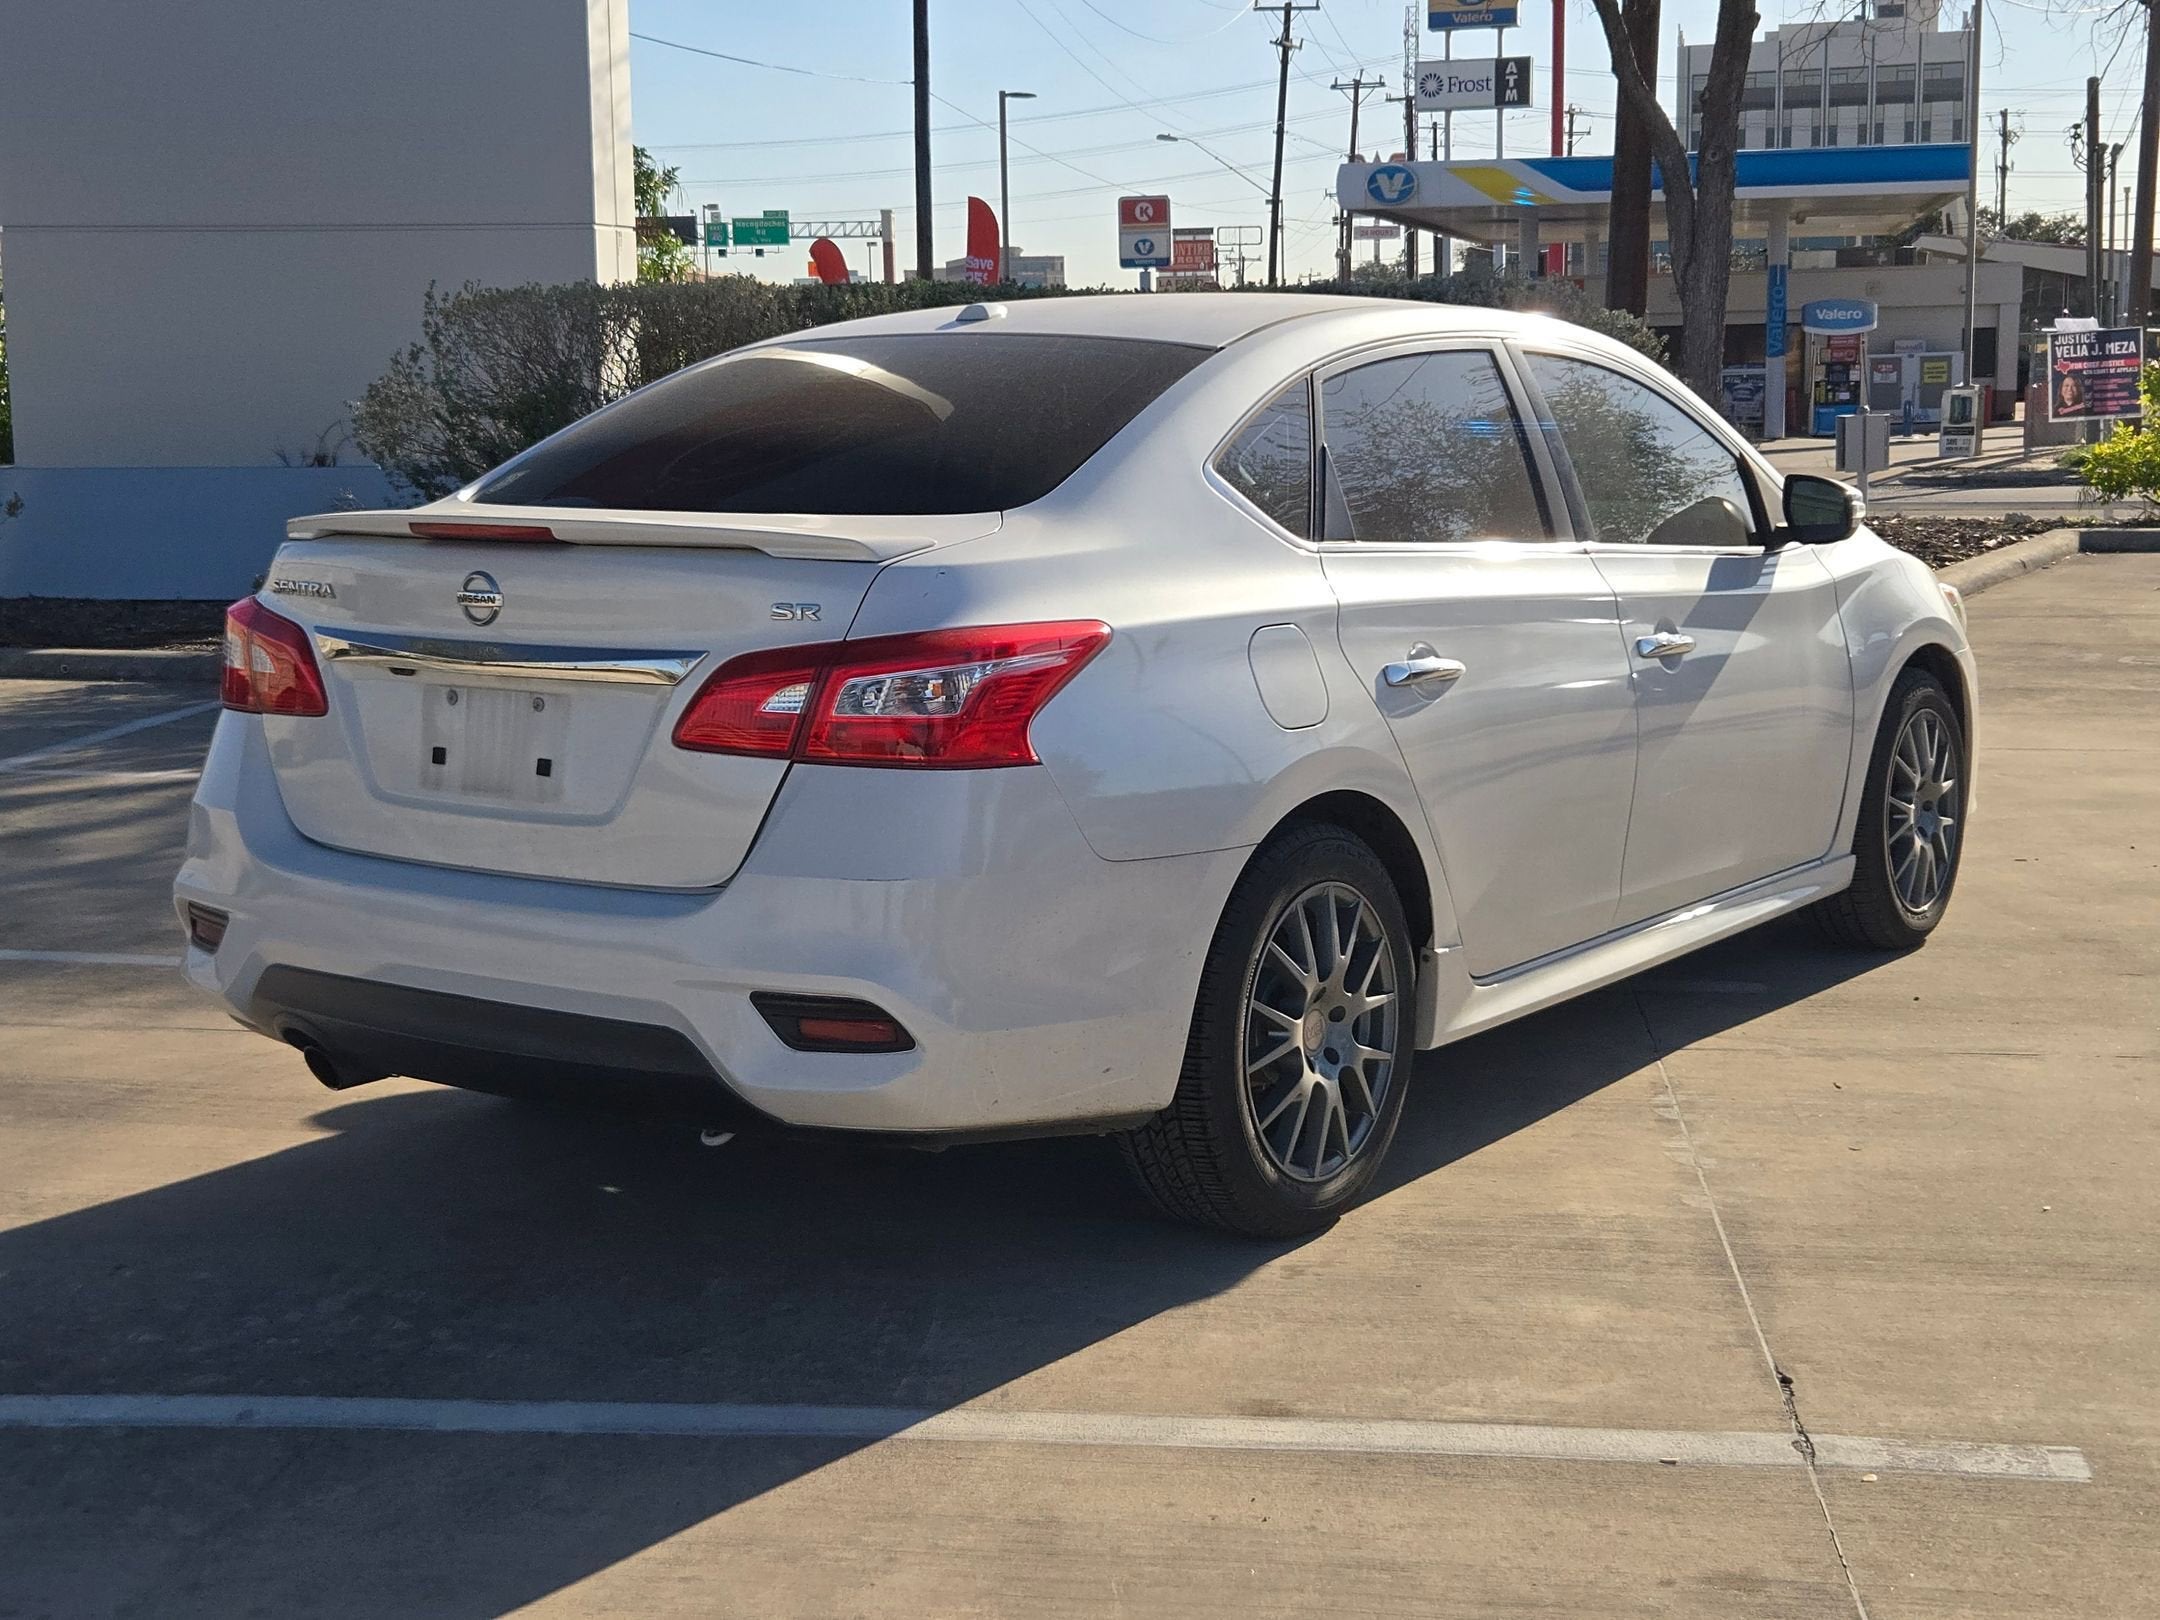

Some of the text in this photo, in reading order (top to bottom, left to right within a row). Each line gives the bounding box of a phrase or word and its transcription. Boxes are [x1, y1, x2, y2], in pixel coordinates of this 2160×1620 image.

[1452, 12, 1494, 23] Valero
[1447, 76, 1492, 93] Frost
[1505, 61, 1518, 102] ATM
[1771, 286, 1784, 352] Valero
[1816, 309, 1862, 320] Valero
[2054, 332, 2097, 345] JUSTICE
[2055, 341, 2137, 358] VELIA J. MEZA
[2100, 359, 2125, 367] JUSTICE
[272, 580, 336, 599] SENTRA
[458, 592, 496, 604] NISSAN
[771, 603, 821, 621] SR
